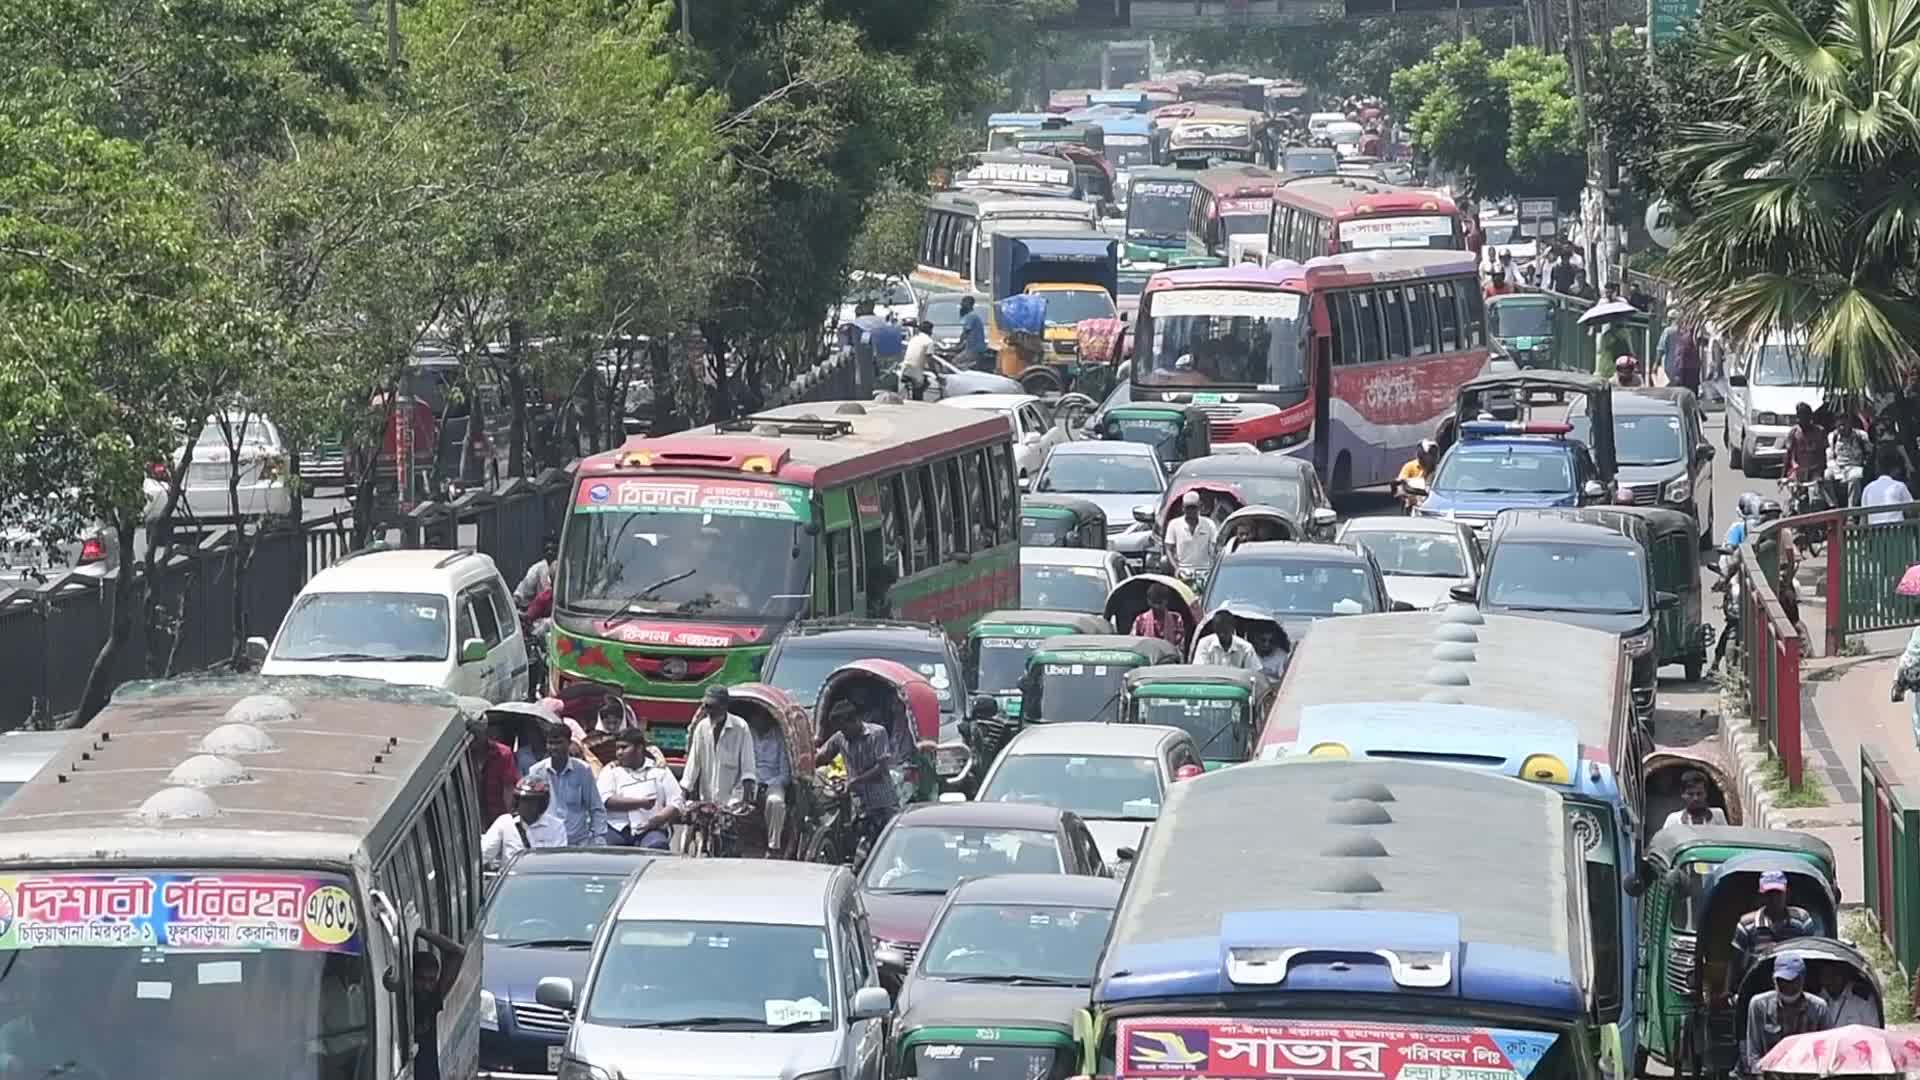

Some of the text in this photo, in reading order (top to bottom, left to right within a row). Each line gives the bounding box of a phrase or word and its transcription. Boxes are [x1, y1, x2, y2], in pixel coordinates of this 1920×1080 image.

[618, 480, 700, 505] ঠিকানা
[622, 623, 670, 642] ঠিকানা
[16, 879, 155, 922] দিশারী
[165, 879, 303, 922] পরিবহন
[19, 922, 84, 943] চিড়িয়াখানা
[1211, 1036, 1388, 1072] সাভার
[1398, 1043, 1467, 1064] পরিবহন
[1473, 1046, 1501, 1065] লিঃ
